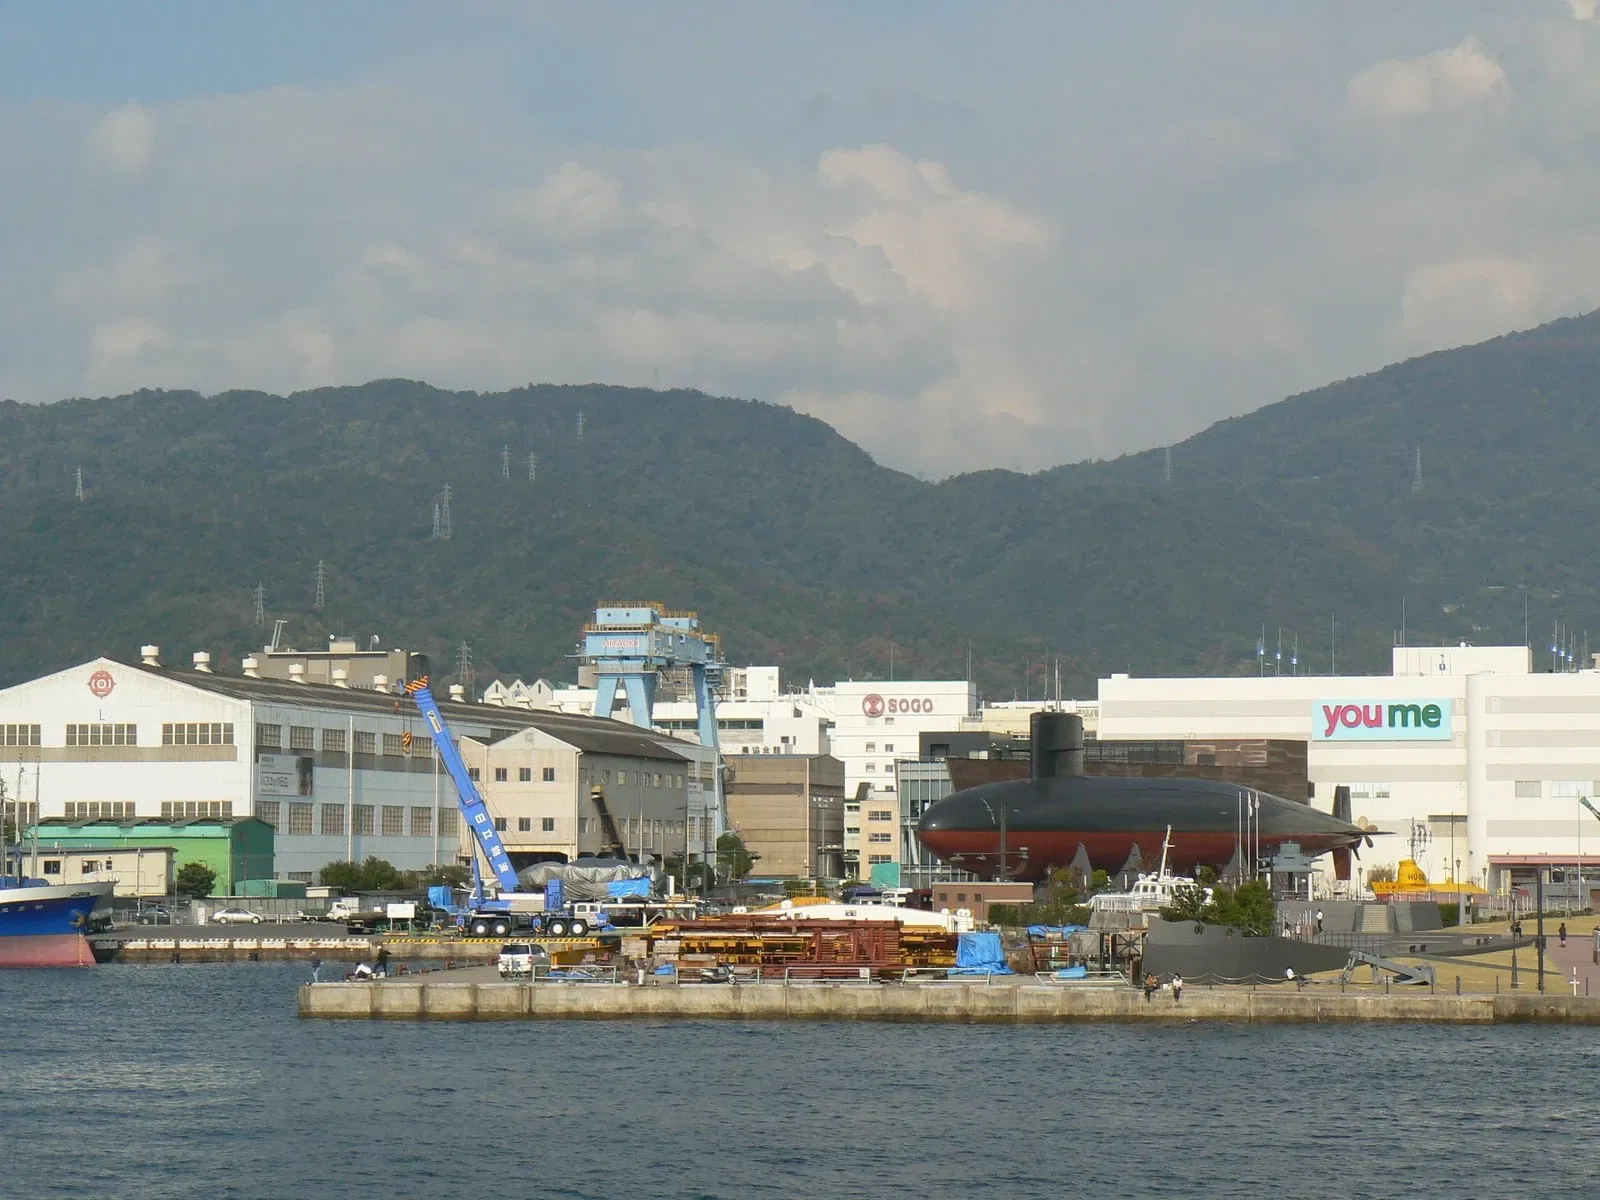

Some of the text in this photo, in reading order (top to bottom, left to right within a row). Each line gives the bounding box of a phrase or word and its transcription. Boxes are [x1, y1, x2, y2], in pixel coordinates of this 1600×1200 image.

[888, 698, 933, 713] SOGO
[1322, 704, 1441, 737] you me
